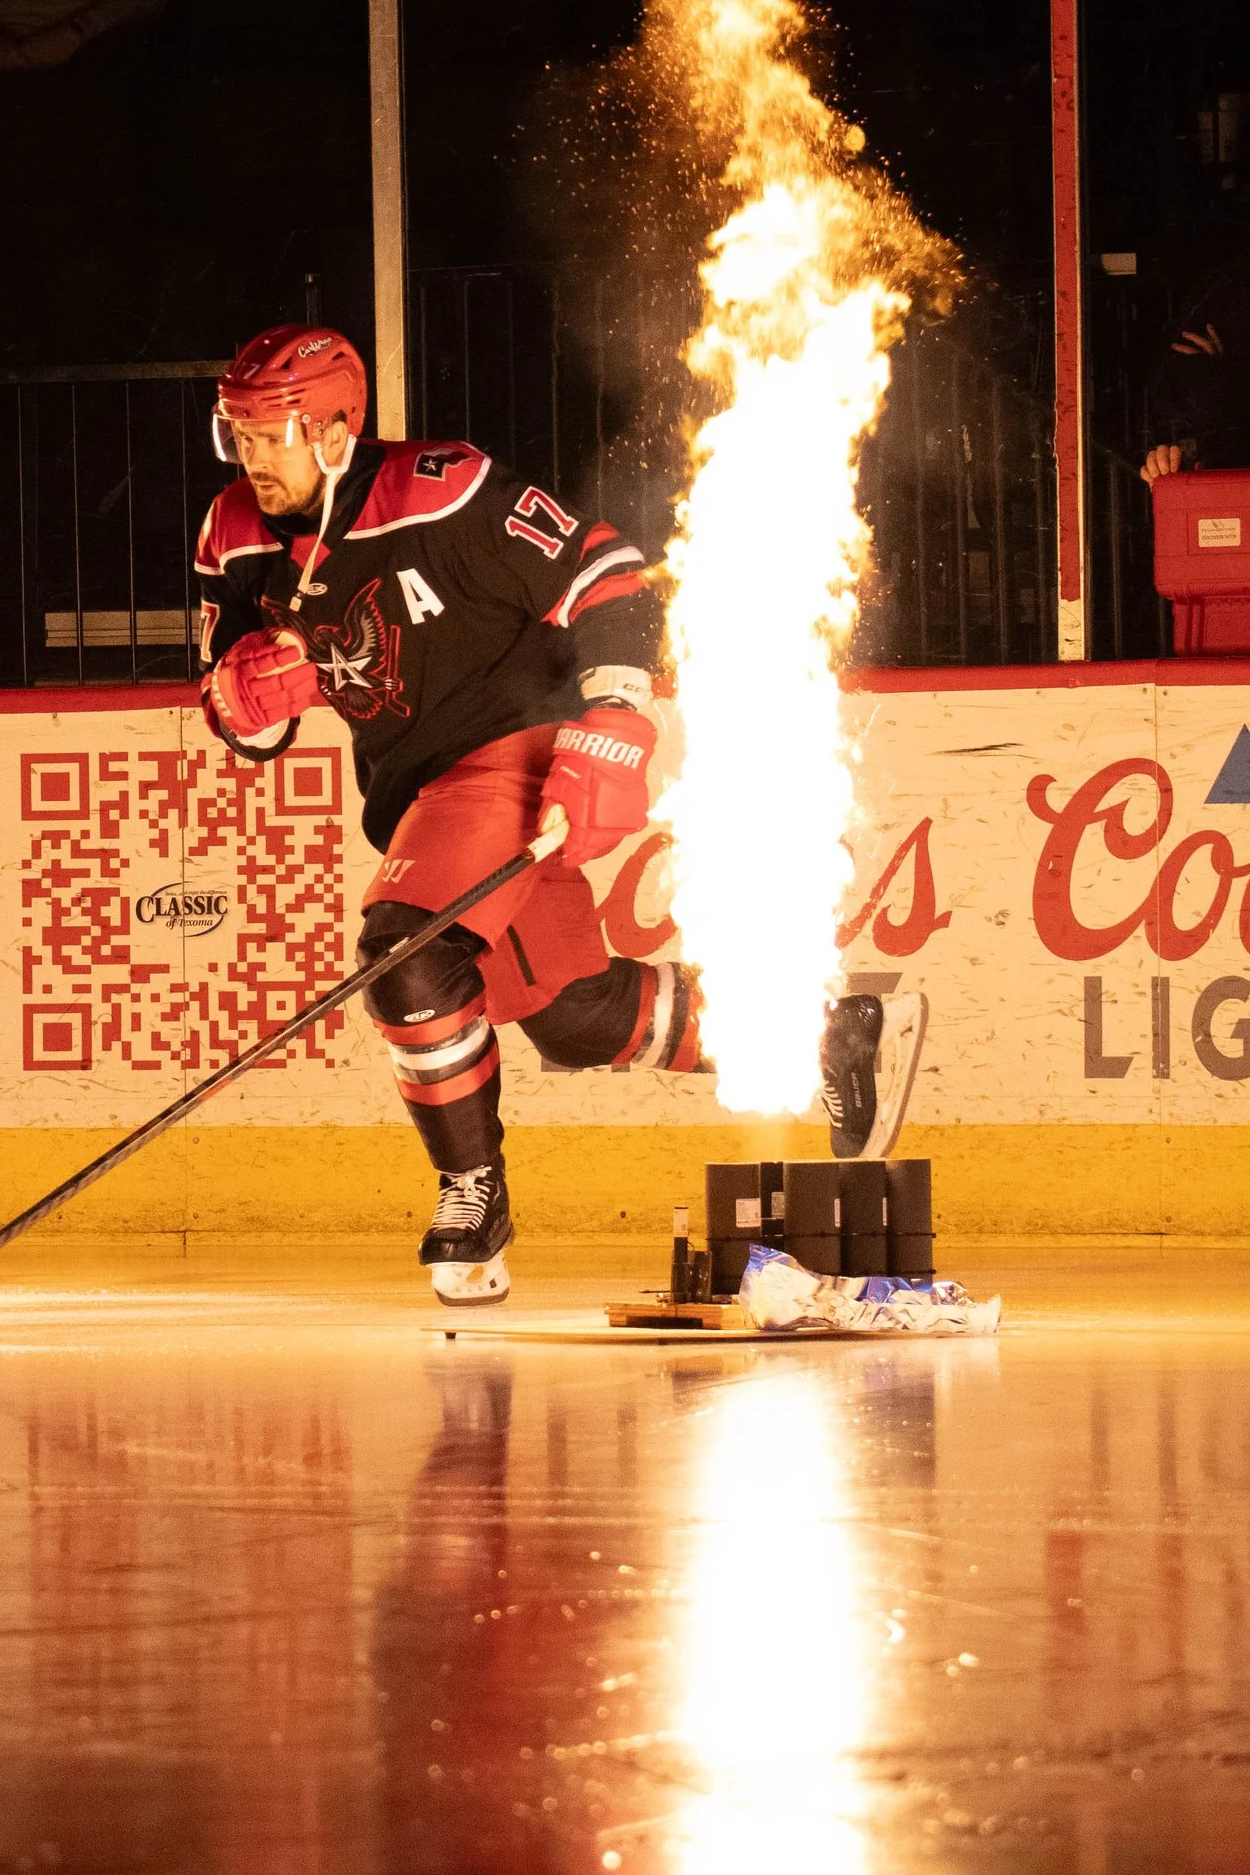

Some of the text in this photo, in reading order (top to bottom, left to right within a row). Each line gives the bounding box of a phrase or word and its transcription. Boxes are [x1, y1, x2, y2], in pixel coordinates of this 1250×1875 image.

[504, 485, 579, 559] 17
[396, 568, 445, 625] A
[1026, 757, 1250, 962] Co
[135, 895, 228, 923] CLASSIC
[165, 918, 213, 930] of Texoma
[1083, 975, 1250, 1081] LIG
